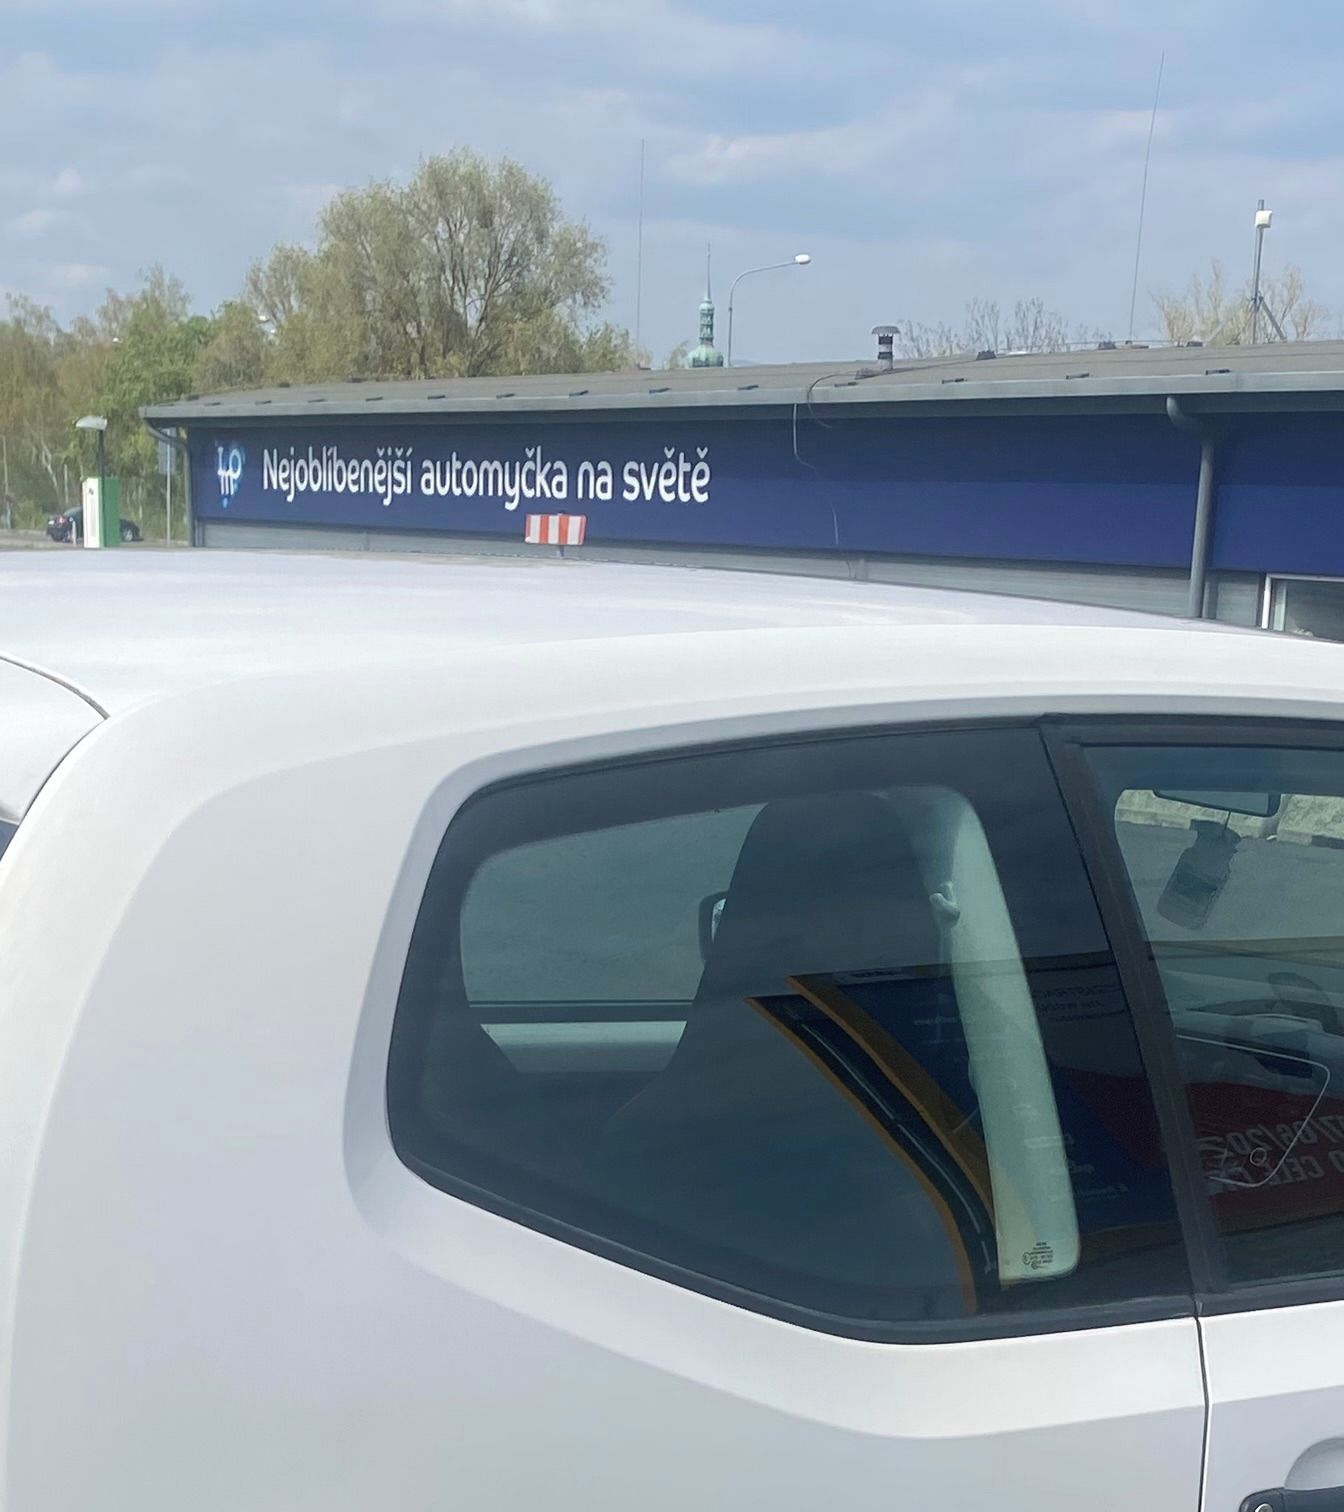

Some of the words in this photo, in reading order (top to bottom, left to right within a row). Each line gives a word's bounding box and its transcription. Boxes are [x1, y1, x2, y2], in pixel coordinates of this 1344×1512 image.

[262, 446, 413, 507] Nejoblíbenější
[420, 445, 568, 511] automyčka
[577, 460, 613, 501] na
[622, 446, 711, 503] světě
